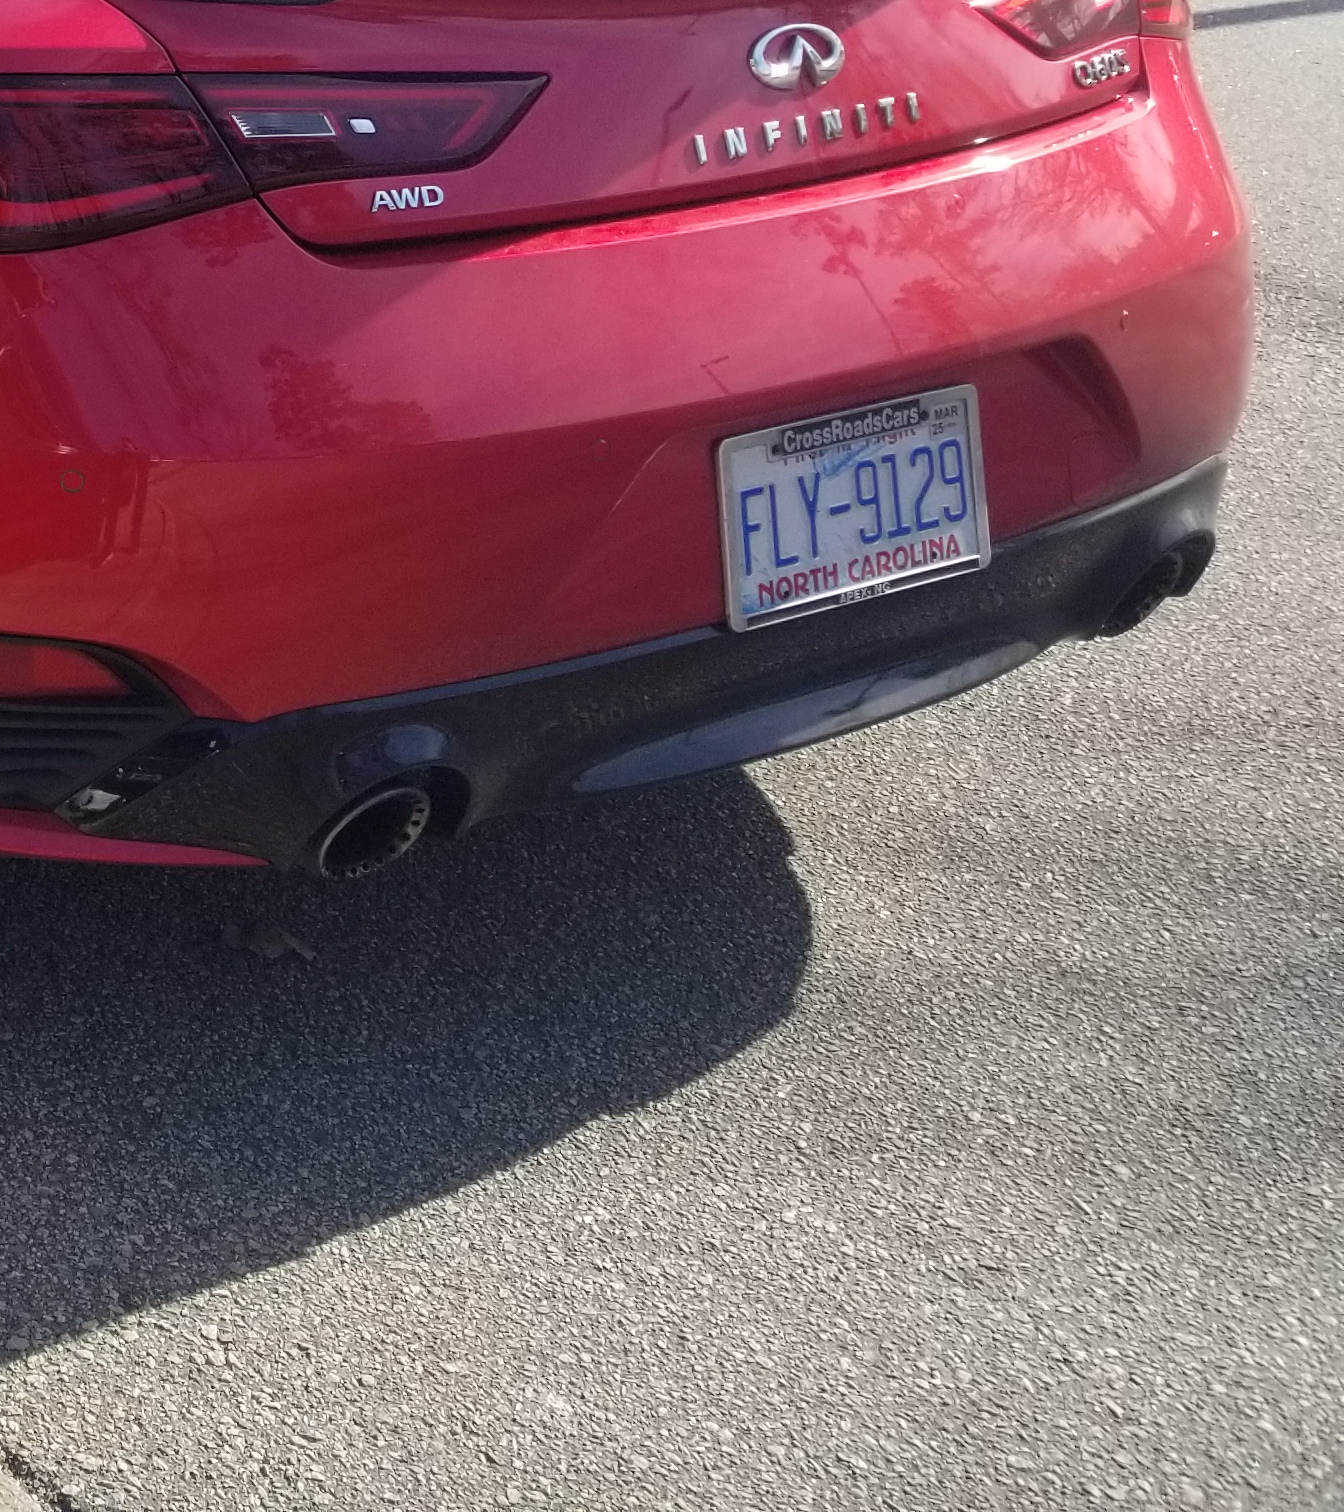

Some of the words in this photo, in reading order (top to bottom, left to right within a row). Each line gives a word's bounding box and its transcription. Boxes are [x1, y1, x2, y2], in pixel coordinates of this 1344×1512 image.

[693, 91, 920, 165] INFINITI
[371, 184, 444, 213] AWD
[782, 404, 920, 453] CrossRoadsCars
[932, 422, 944, 435] 25
[934, 405, 959, 419] MAR
[739, 438, 968, 576] FLY-9129
[847, 533, 962, 582] CAROLINA
[758, 562, 839, 608] NORTH
